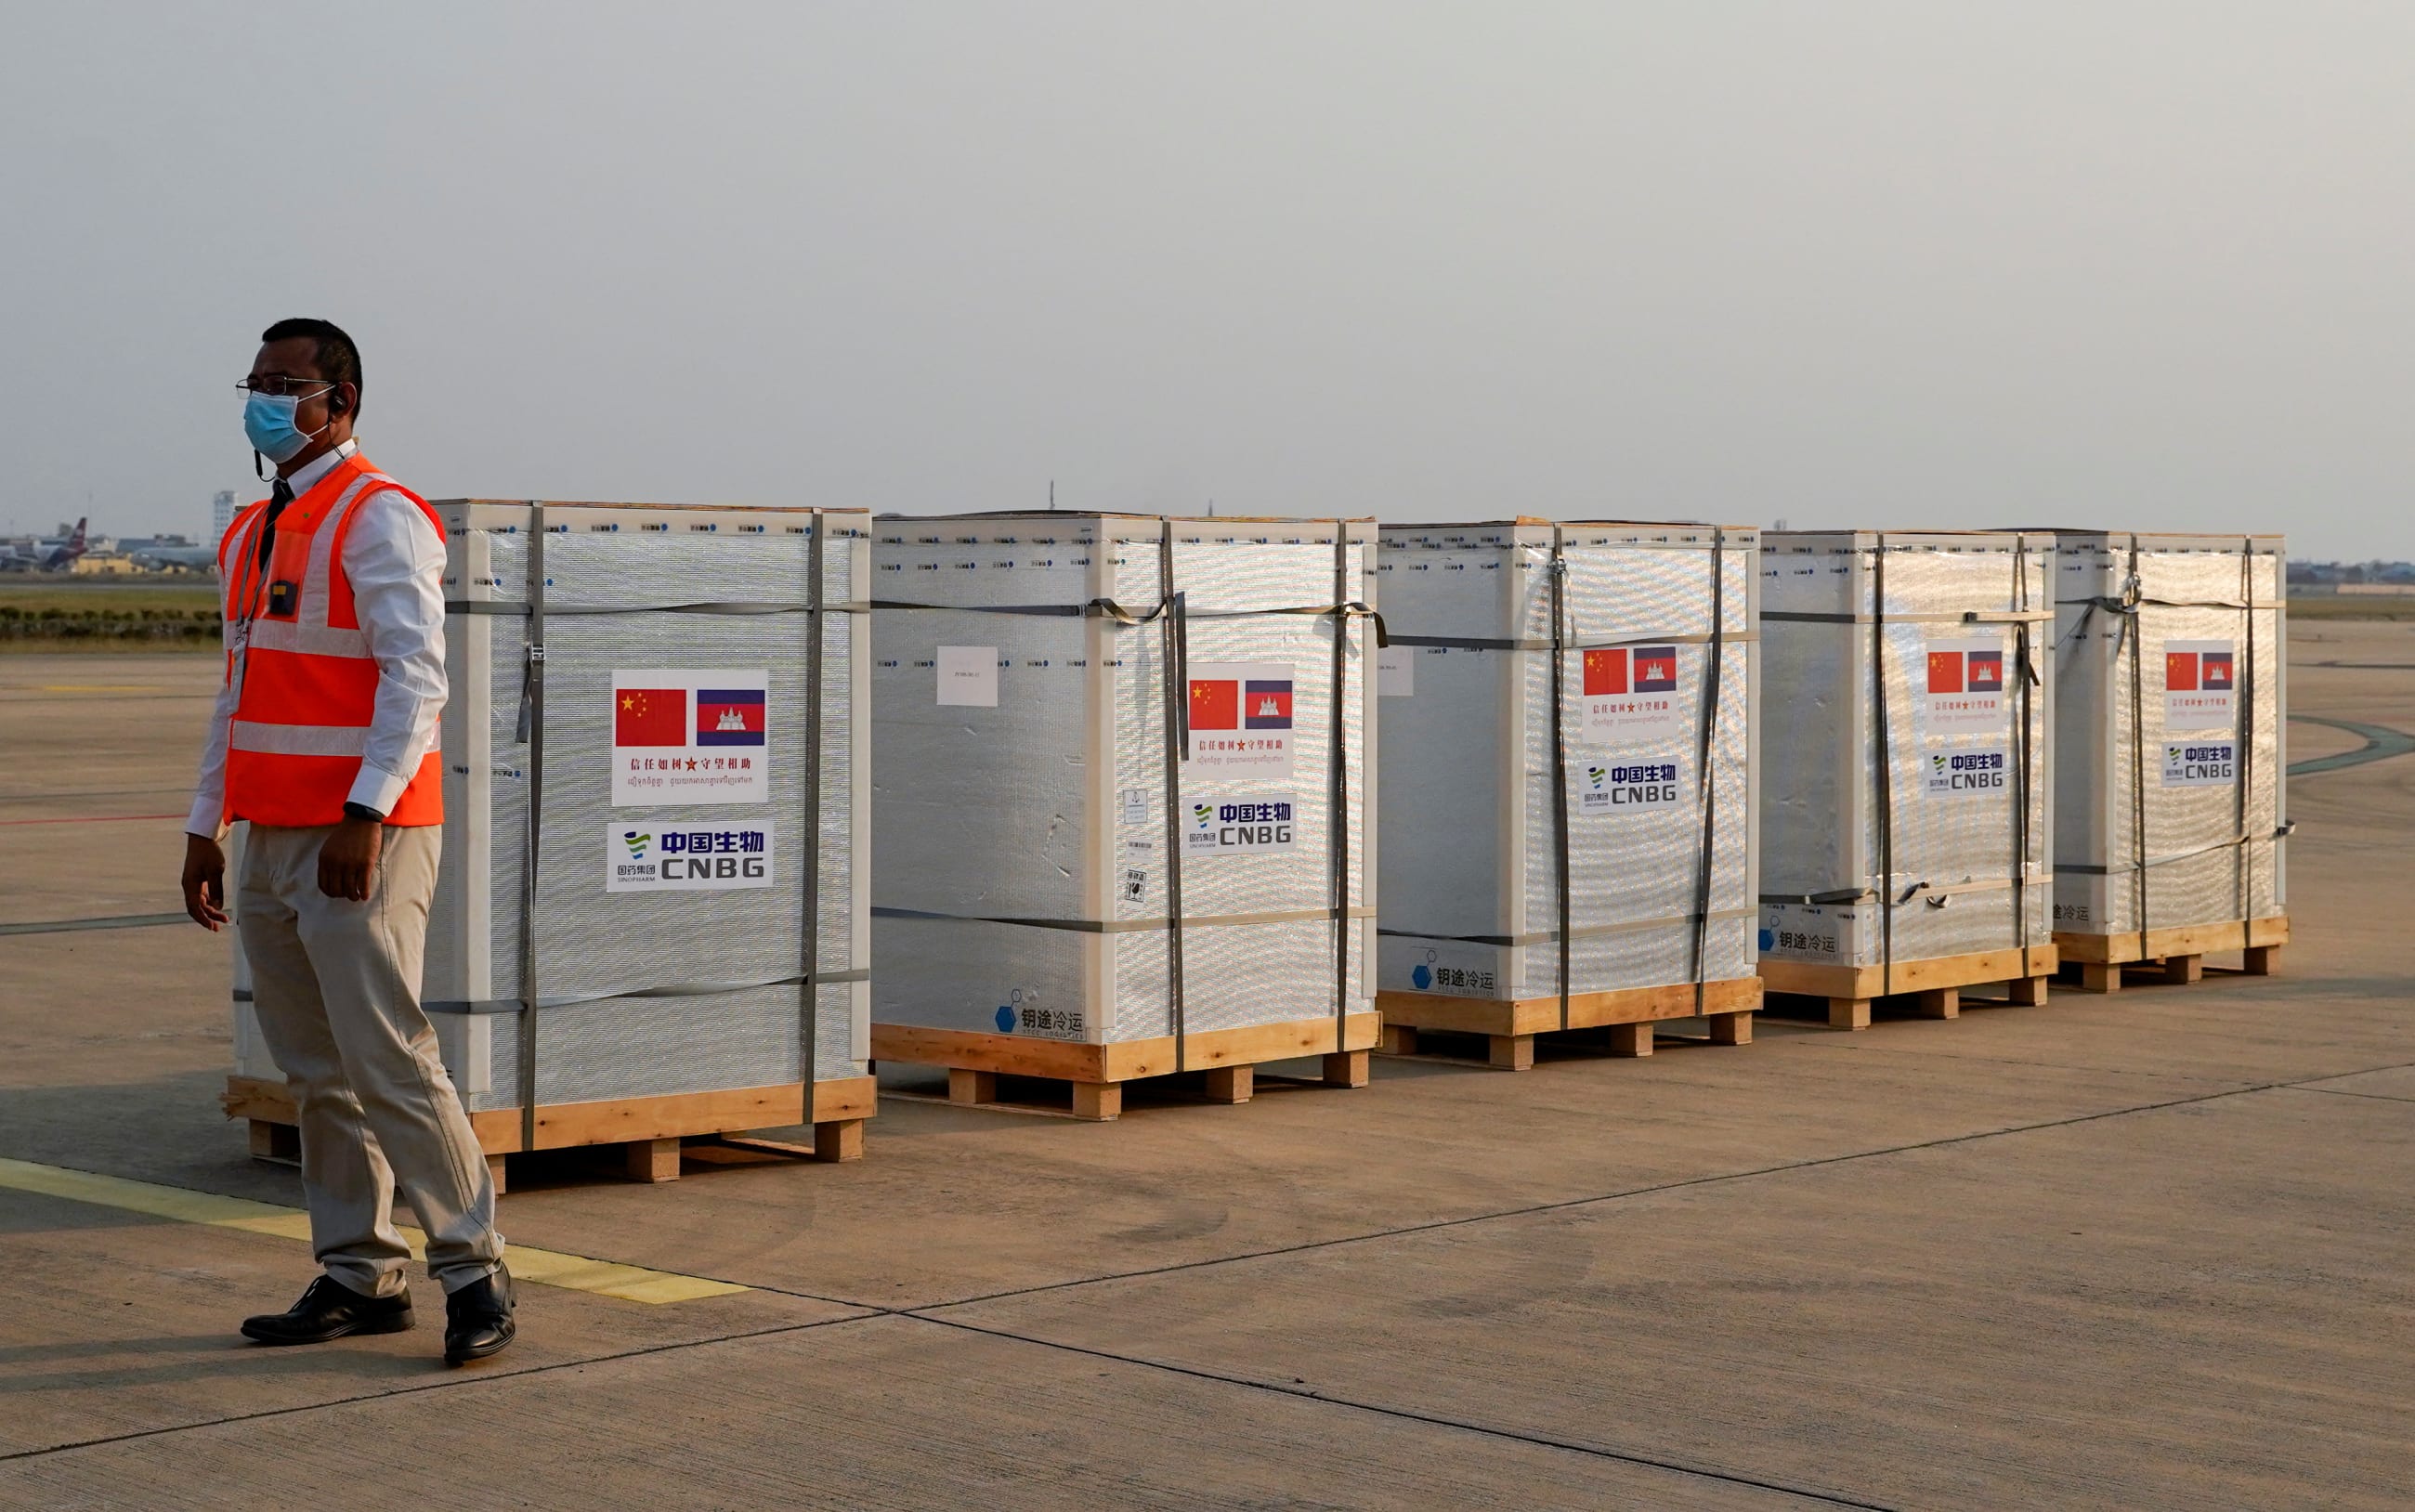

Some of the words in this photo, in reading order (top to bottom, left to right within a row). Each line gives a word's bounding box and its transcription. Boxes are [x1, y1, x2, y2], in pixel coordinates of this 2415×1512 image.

[1951, 753, 2003, 772] 中国生物
[2185, 746, 2232, 763] 中国生物
[1612, 763, 1677, 785] 中国生物
[1952, 772, 2003, 789] CNBG
[2185, 763, 2232, 779] CNBG
[1612, 784, 1677, 805] CNBG
[1220, 802, 1291, 824] 中国生物
[660, 830, 764, 854] 中国生物
[1220, 825, 1291, 846] CNBG
[661, 856, 764, 880] CNBG
[1779, 931, 1836, 953] 钥途冷运
[1437, 967, 1495, 990] 钥途冷运
[1022, 1009, 1083, 1032] 钥途冷运
